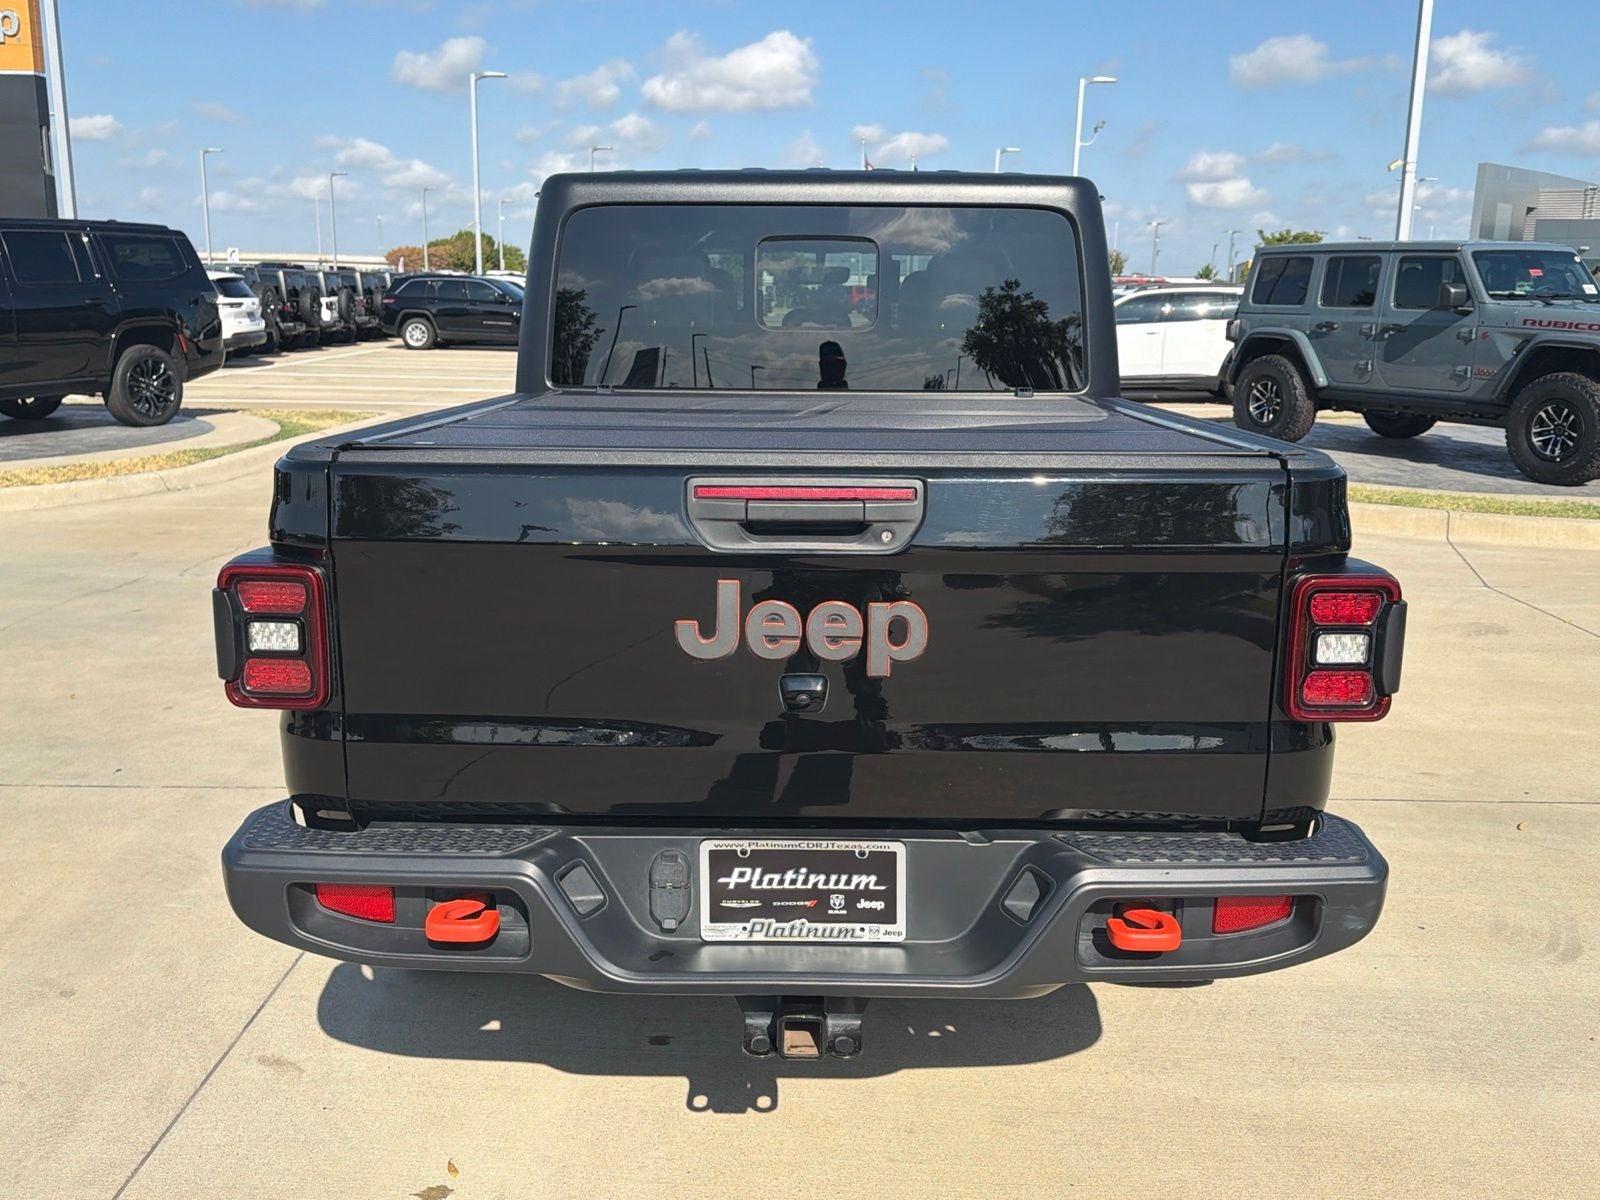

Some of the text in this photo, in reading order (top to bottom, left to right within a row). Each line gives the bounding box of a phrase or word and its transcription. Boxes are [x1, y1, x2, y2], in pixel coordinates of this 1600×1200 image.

[675, 579, 928, 677] Jeep
[713, 841, 891, 850] www.PlatinumCDRJTexas.com
[717, 867, 887, 890] Platinum
[857, 898, 885, 911] Jeep
[748, 920, 865, 939] Platinum
[882, 929, 903, 937] Jeep
